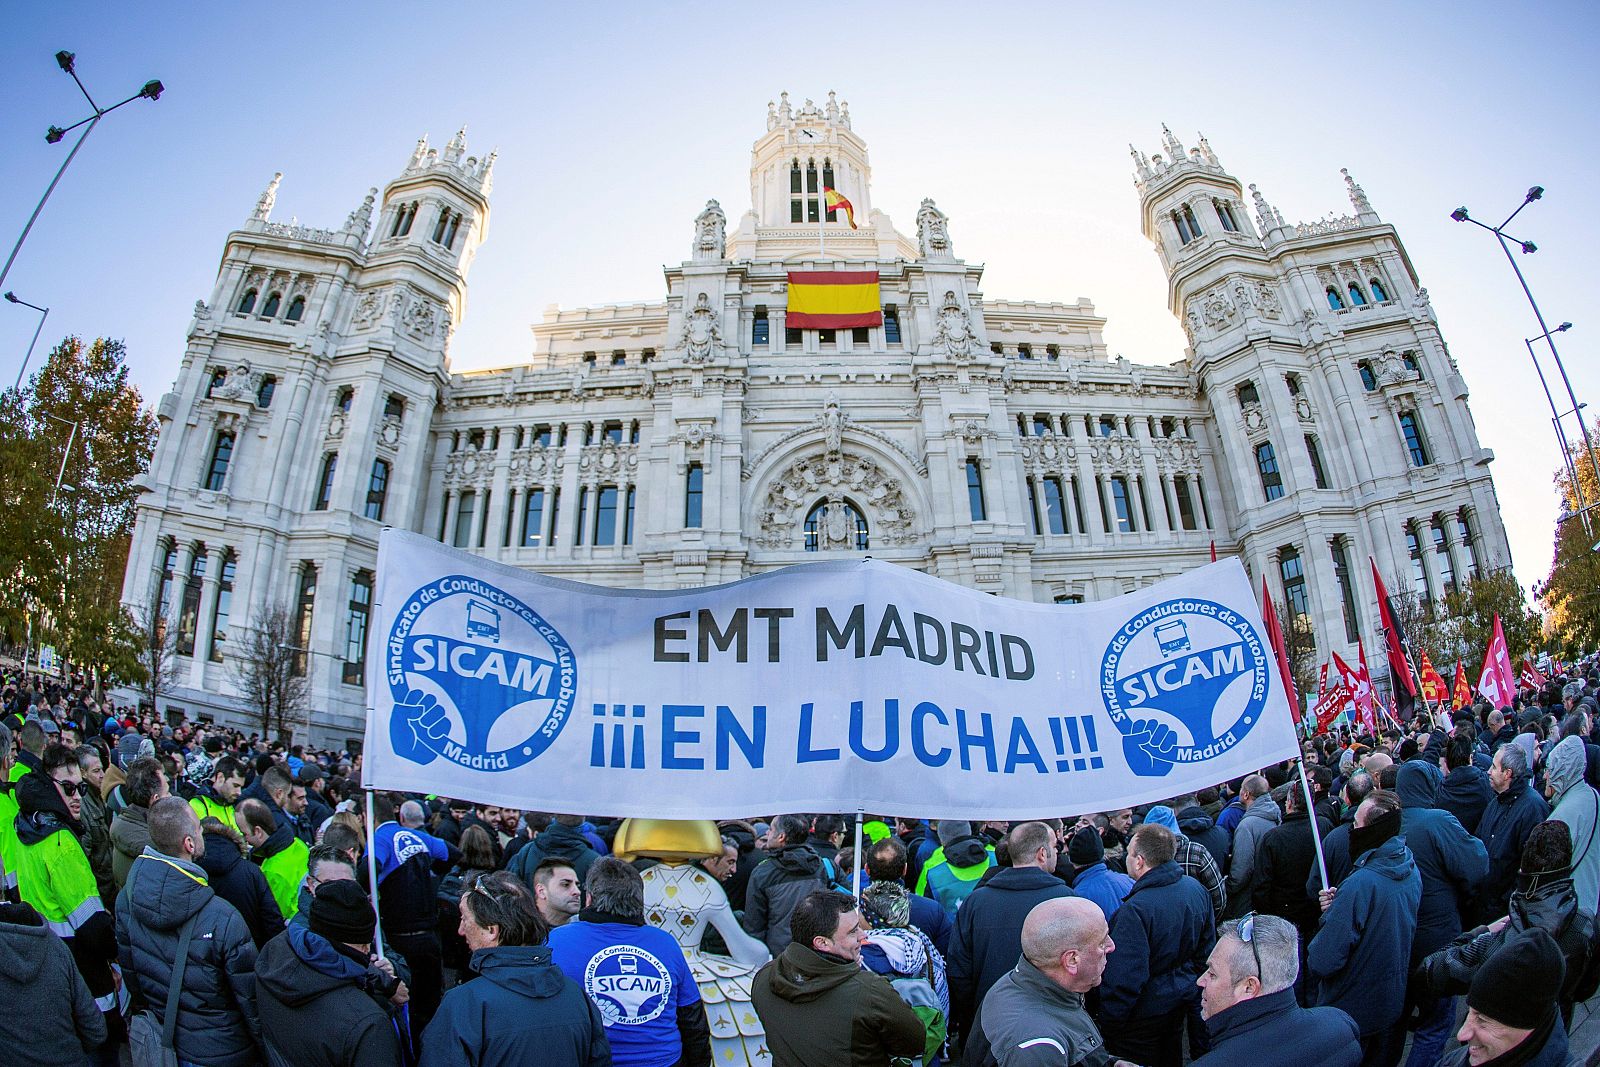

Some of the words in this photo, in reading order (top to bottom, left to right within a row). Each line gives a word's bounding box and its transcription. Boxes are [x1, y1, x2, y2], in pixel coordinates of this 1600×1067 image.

[420, 587, 439, 604] de
[439, 578, 540, 626] Conductores
[1125, 600, 1218, 637] Conductores
[1218, 610, 1237, 625] de
[389, 601, 421, 686] Sindicato
[538, 625, 559, 643] de
[653, 607, 795, 663] EMT
[816, 603, 1036, 682] MADRID
[1114, 636, 1128, 653] de
[413, 638, 554, 696] SICAM
[1122, 645, 1246, 707] SICAM
[1235, 620, 1266, 702] Autobuses
[542, 644, 575, 737] Autobuses
[1103, 654, 1126, 723] Sindicato
[442, 741, 509, 769] Madrid
[796, 698, 1104, 775] LUCHA!!!
[1176, 731, 1237, 761] Madrid
[586, 963, 596, 999] Sindicato
[594, 954, 604, 963] de
[603, 946, 652, 961] Conductores
[653, 960, 663, 970] de
[597, 977, 661, 993] SICAM
[617, 1015, 648, 1024] Madrid
